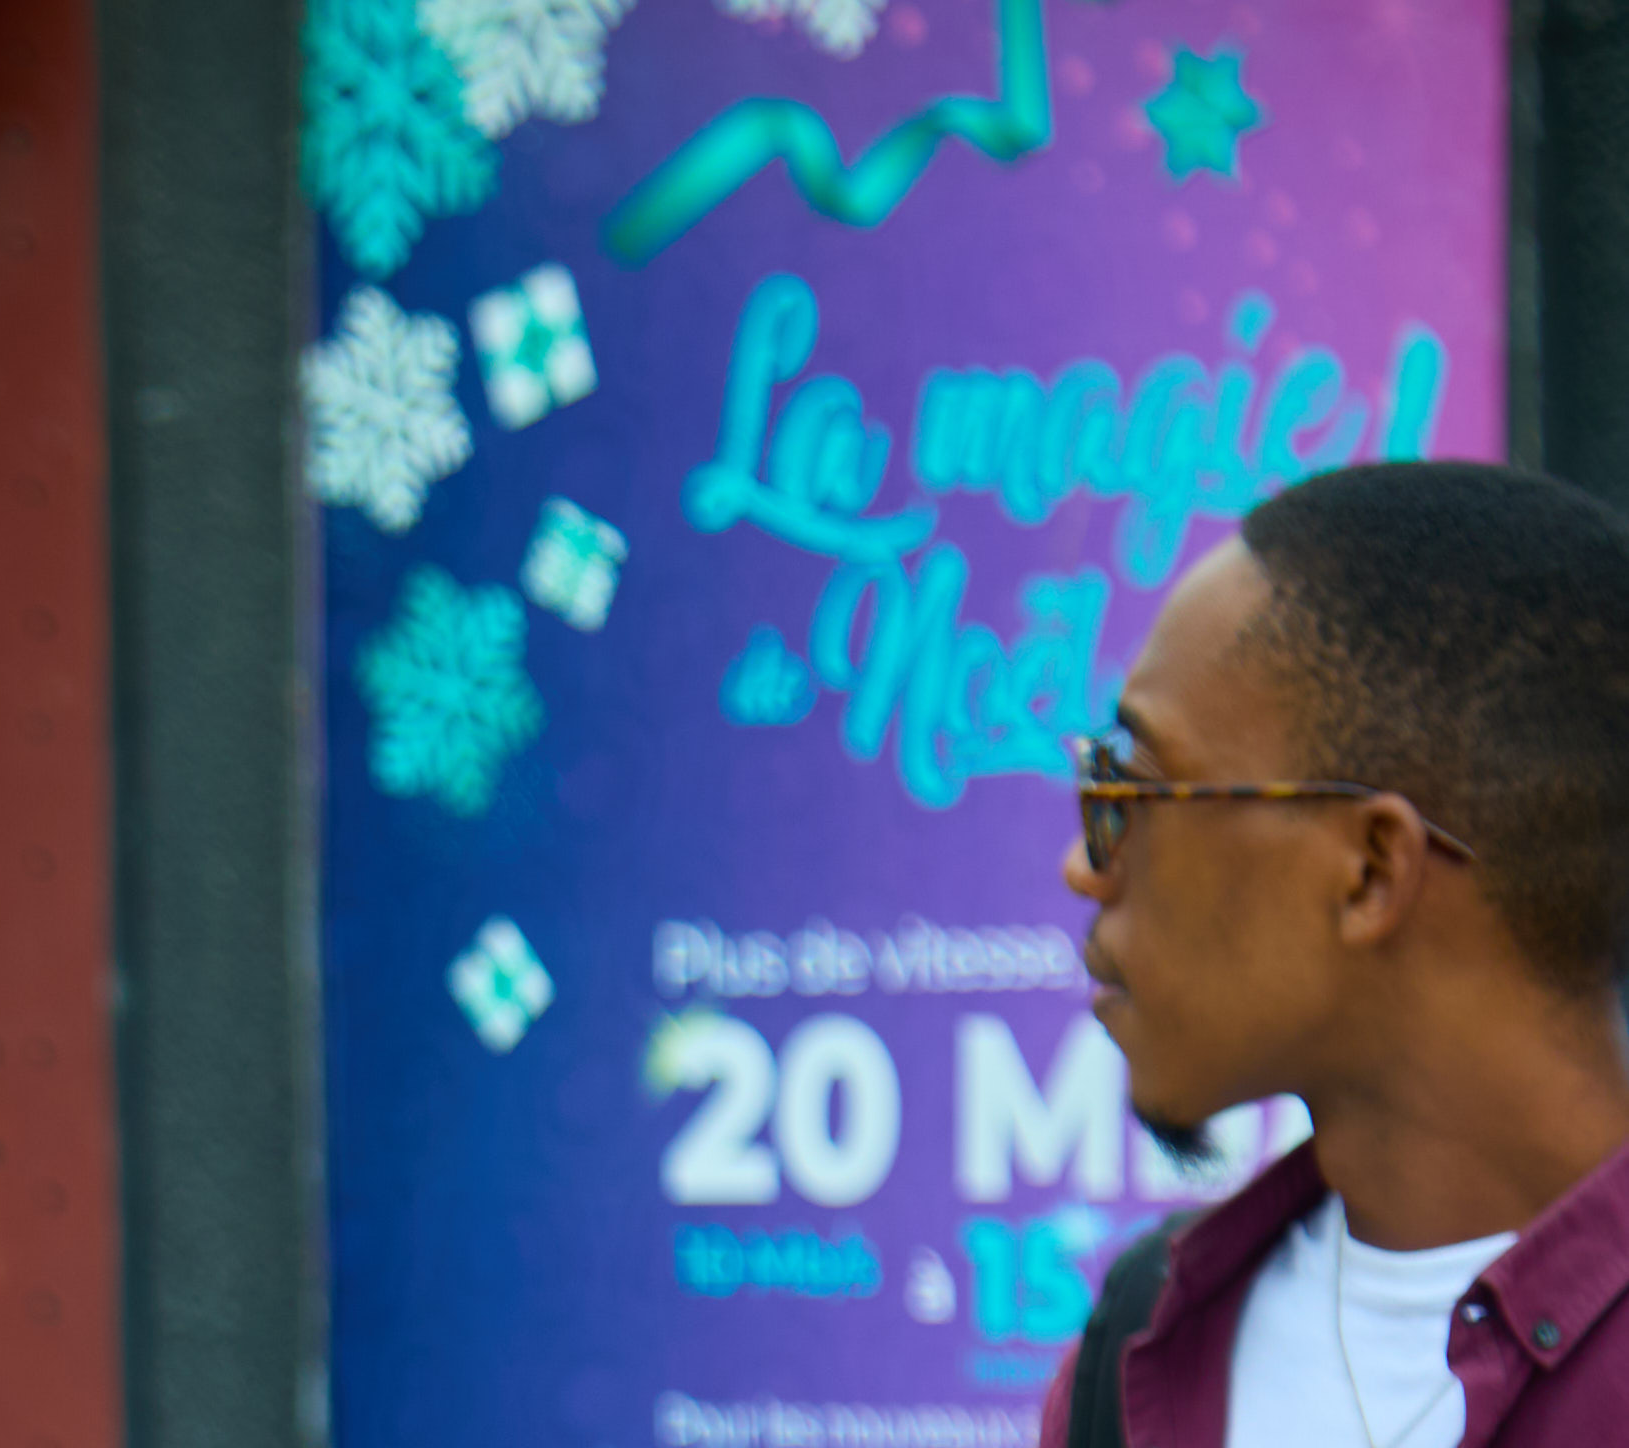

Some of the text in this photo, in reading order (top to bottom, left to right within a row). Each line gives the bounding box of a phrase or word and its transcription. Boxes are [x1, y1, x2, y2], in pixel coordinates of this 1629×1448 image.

[681, 272, 938, 562] La
[653, 918, 788, 998] Plus
[785, 915, 873, 998] de
[658, 1010, 903, 1207] 20
[906, 1243, 958, 1326] à
